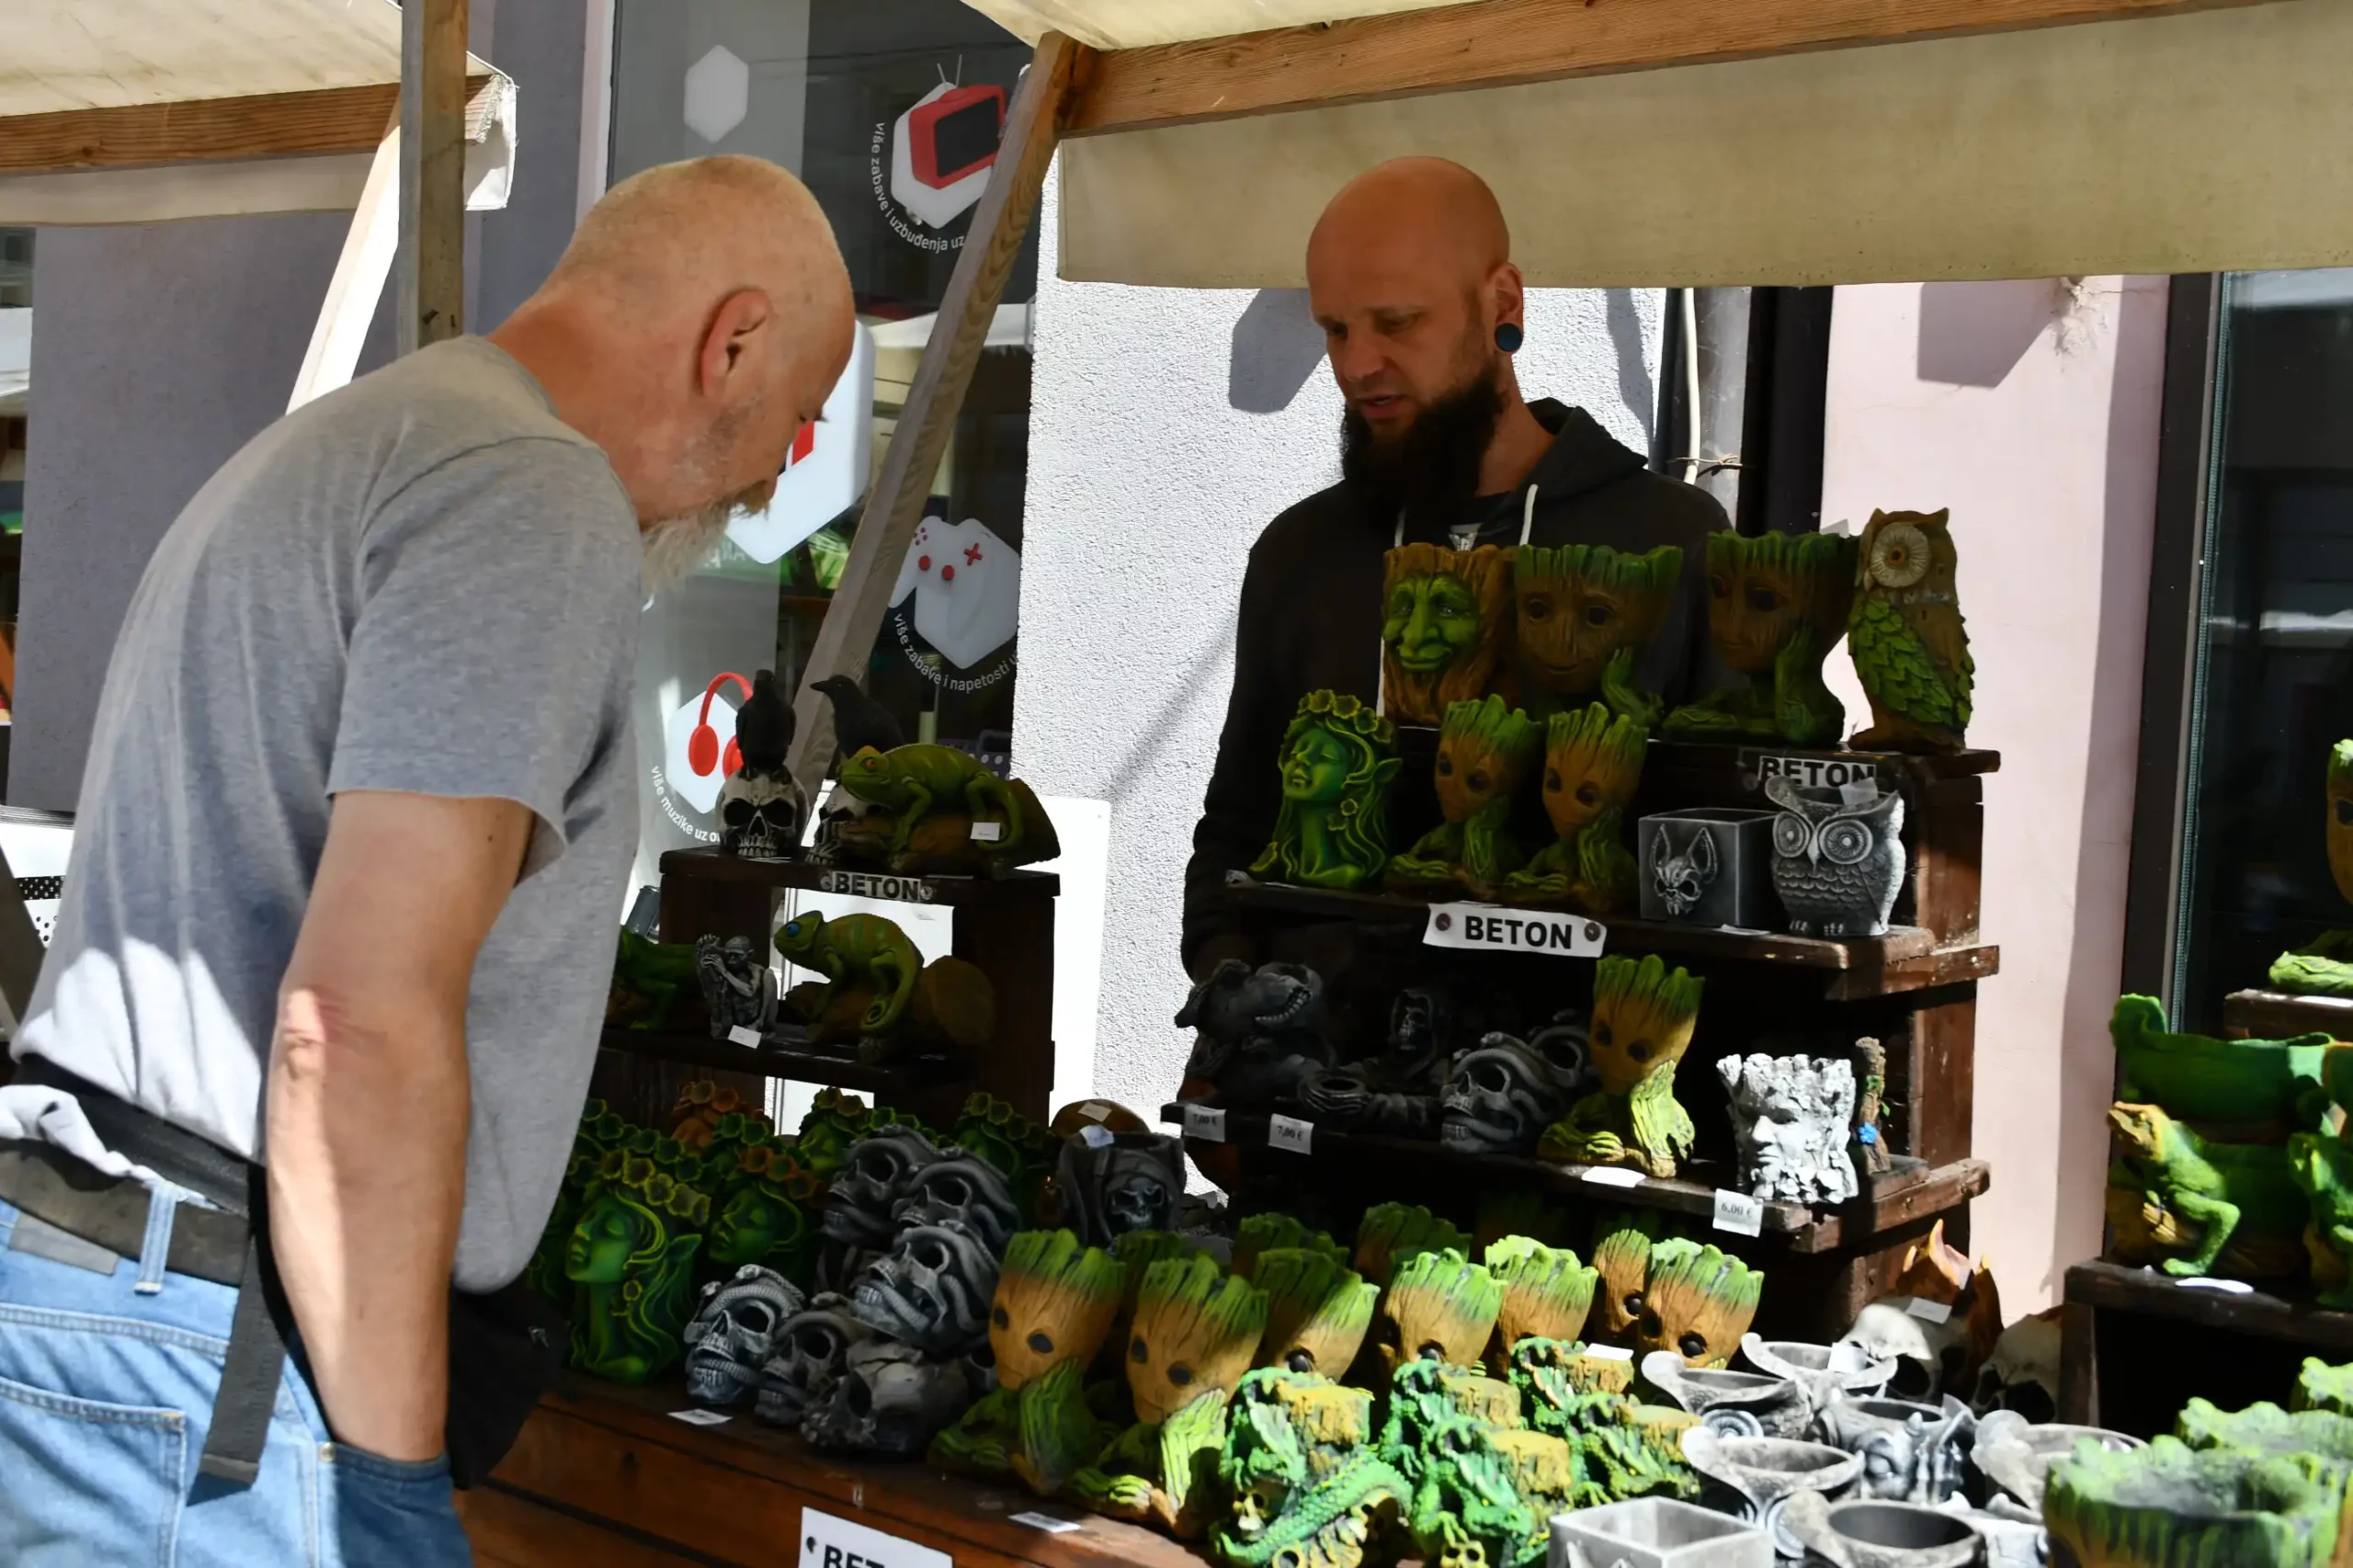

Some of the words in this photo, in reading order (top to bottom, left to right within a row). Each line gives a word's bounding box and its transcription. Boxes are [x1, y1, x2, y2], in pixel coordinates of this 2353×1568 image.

[870, 122, 885, 153] više
[870, 157, 889, 210] zabave
[889, 215, 948, 254] uzbuđenja
[950, 235, 965, 249] uz
[893, 613, 909, 645] više
[904, 645, 942, 685] zabave
[943, 674, 949, 687] i
[949, 660, 1010, 694] napetosti
[1759, 757, 1874, 787] BETON
[661, 796, 693, 835] muzike
[694, 828, 708, 842] uz
[835, 873, 919, 900] BETON
[1465, 915, 1573, 949] BETON
